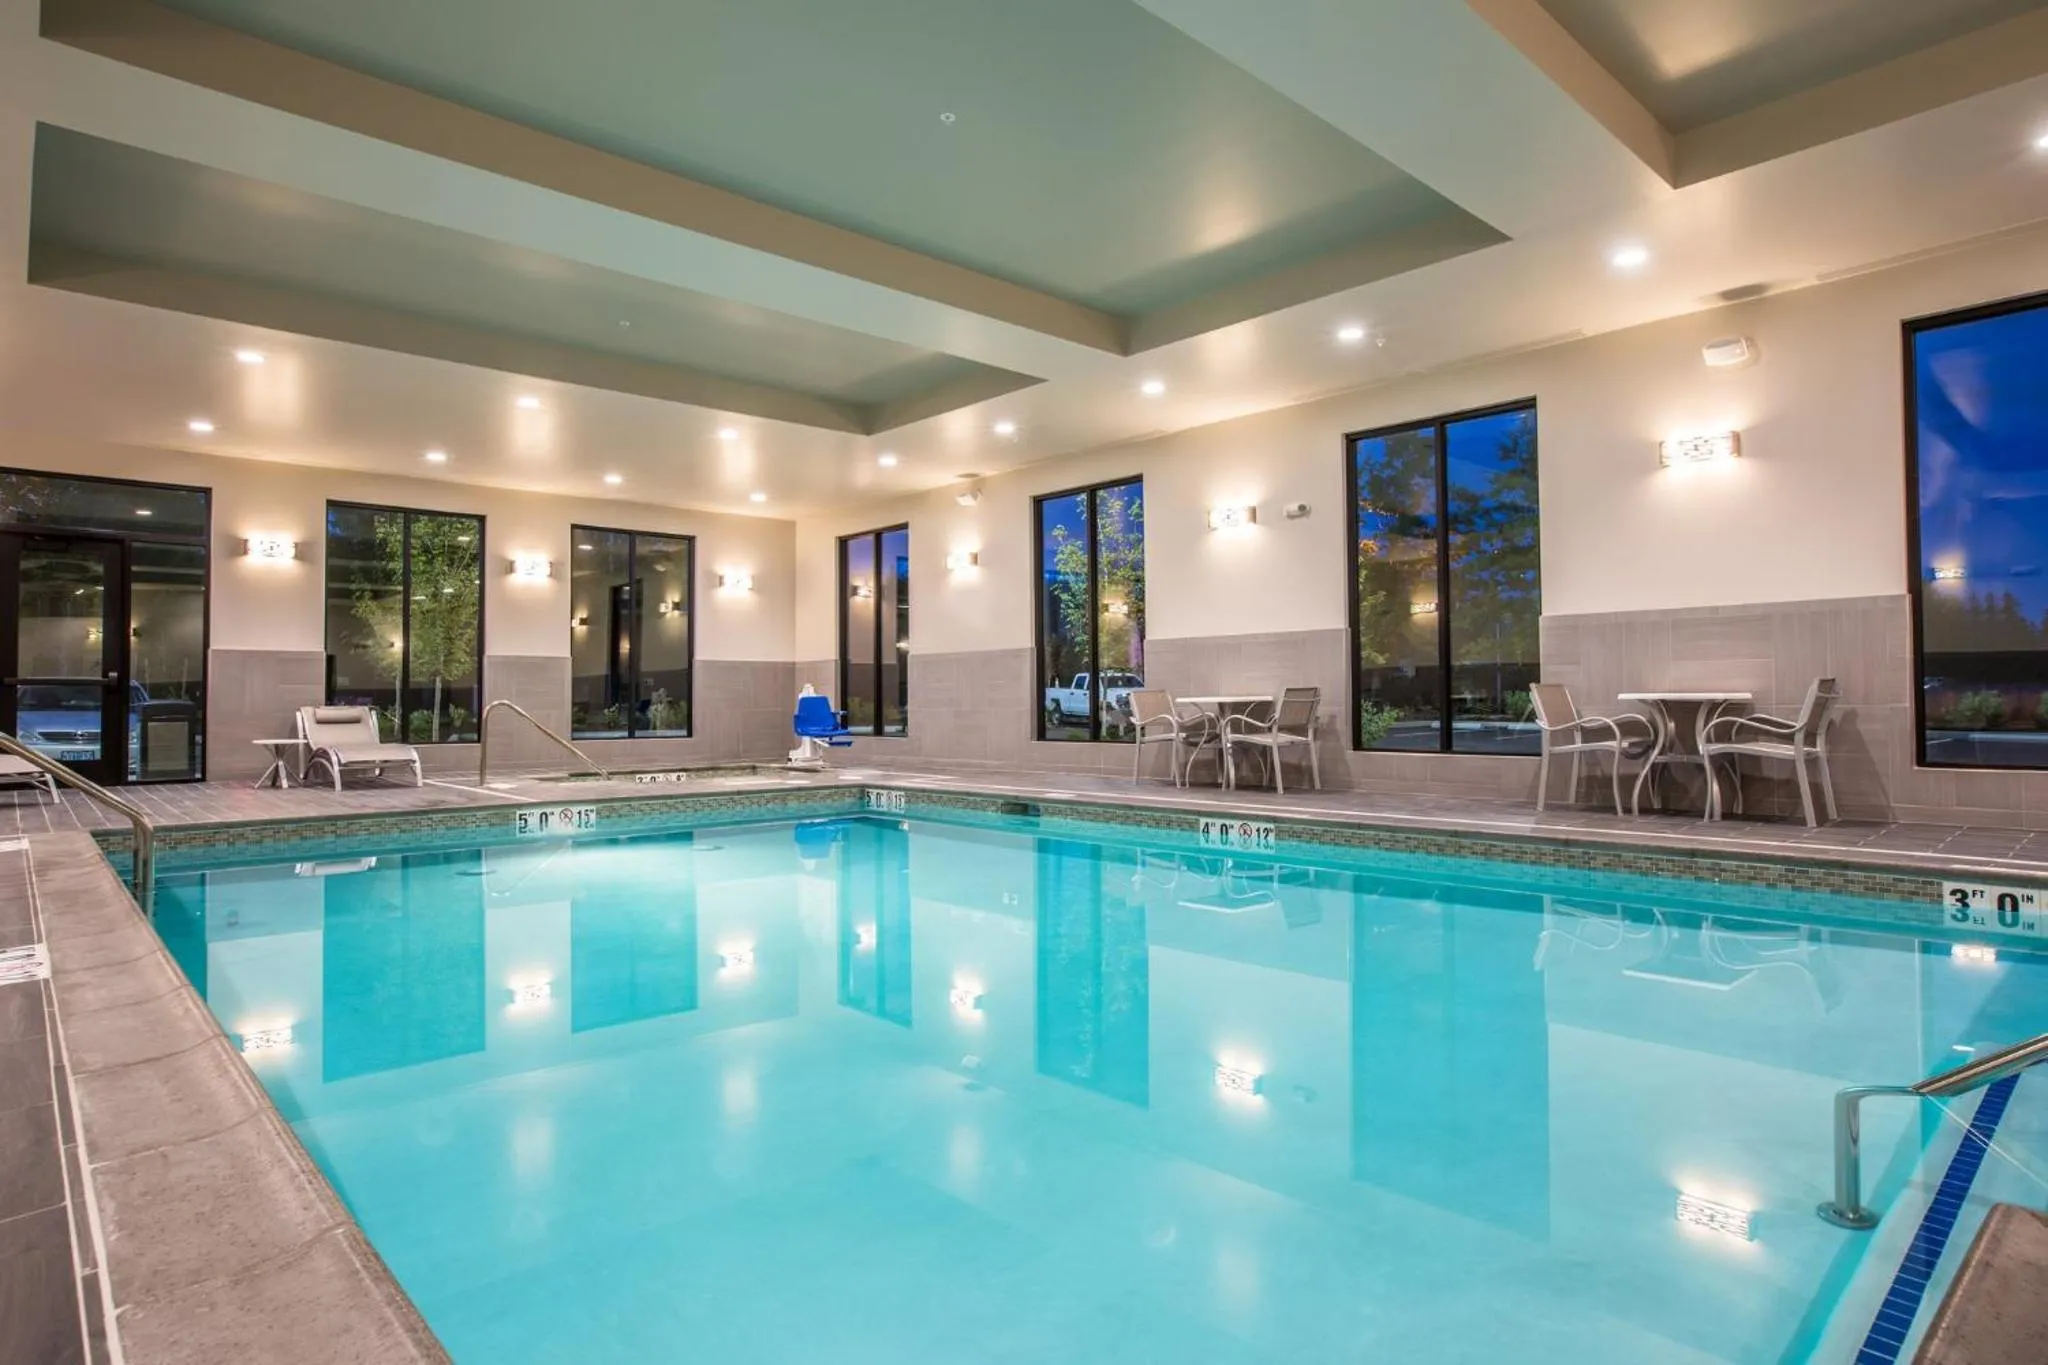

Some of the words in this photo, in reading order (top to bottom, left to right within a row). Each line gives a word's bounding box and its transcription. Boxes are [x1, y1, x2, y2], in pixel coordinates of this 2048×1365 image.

[518, 812, 528, 827] 5
[1202, 821, 1210, 836] 4
[1220, 823, 1229, 837] 0
[1949, 888, 1970, 910] 3
[1972, 890, 1985, 898] FT
[1997, 892, 2020, 914] 0
[2021, 894, 2034, 903] IN
